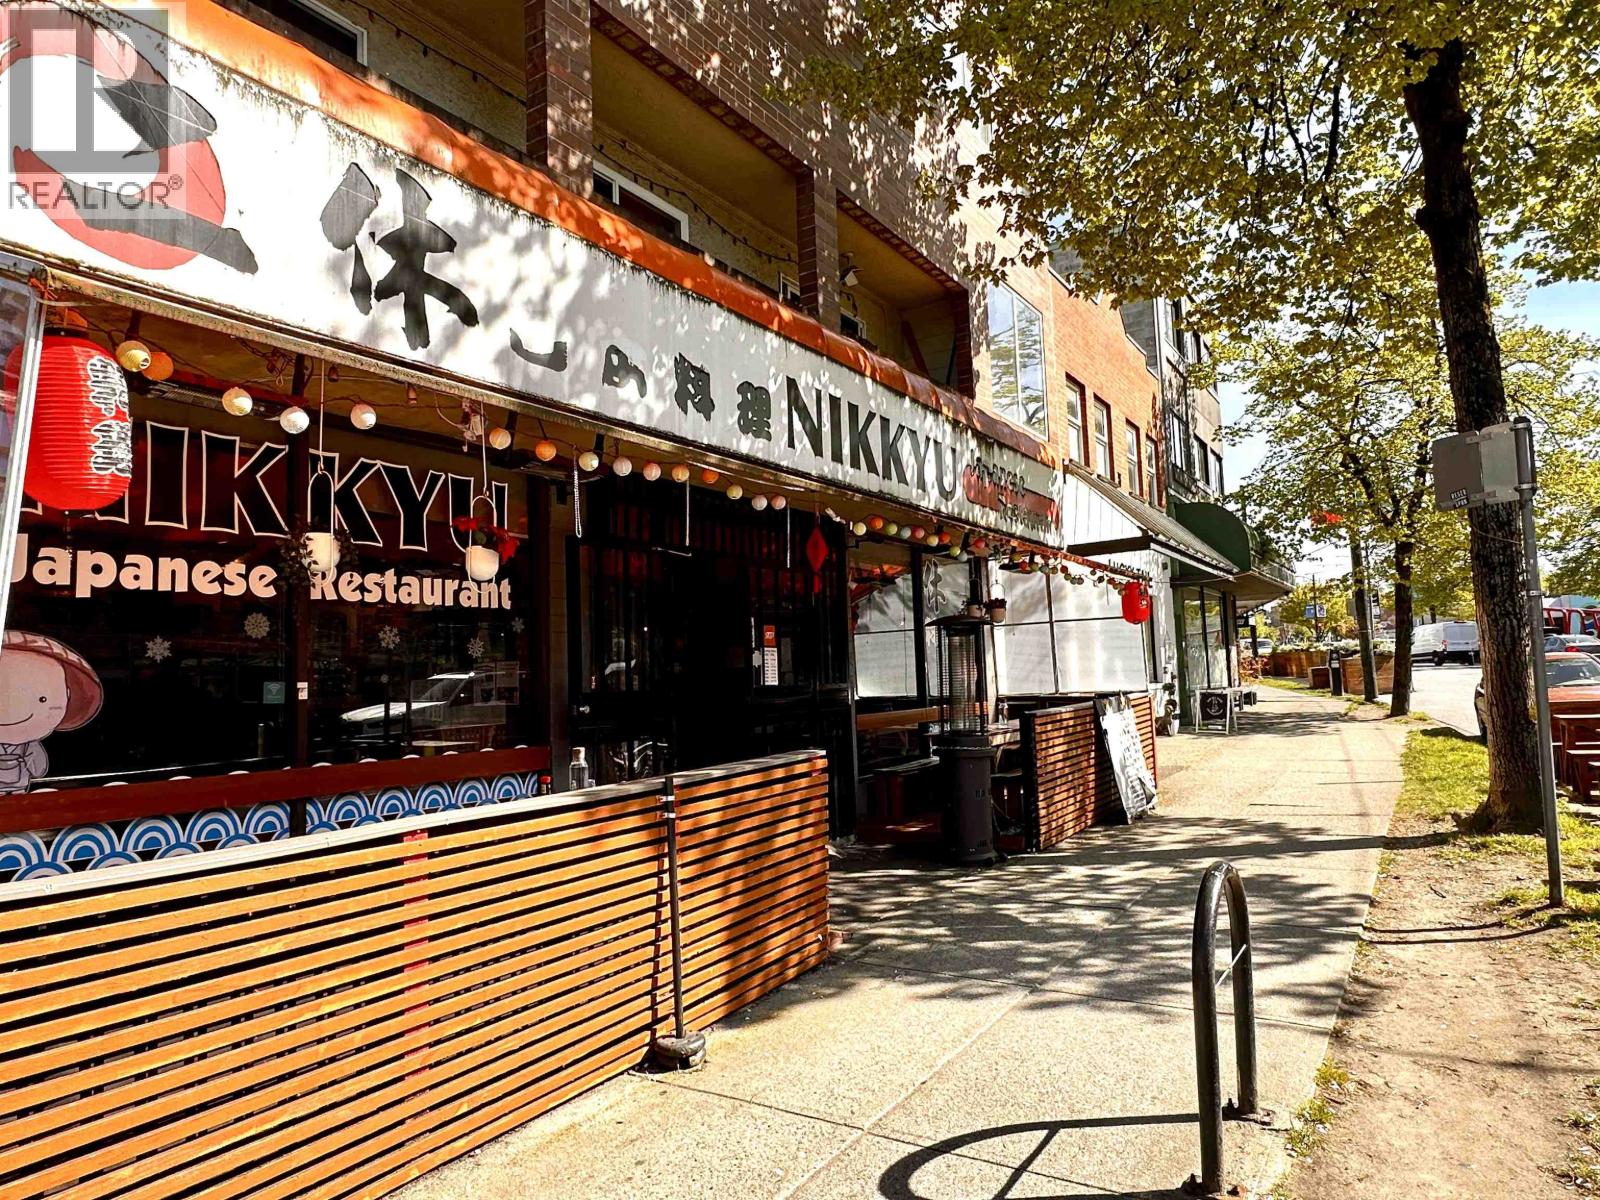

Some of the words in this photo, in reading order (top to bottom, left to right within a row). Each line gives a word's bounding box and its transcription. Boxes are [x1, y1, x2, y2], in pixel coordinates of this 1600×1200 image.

[22, 420, 510, 553] IKKYU
[786, 376, 957, 502] NIKKYU
[10, 533, 278, 599] Japanese
[308, 566, 513, 611] Restaurant
